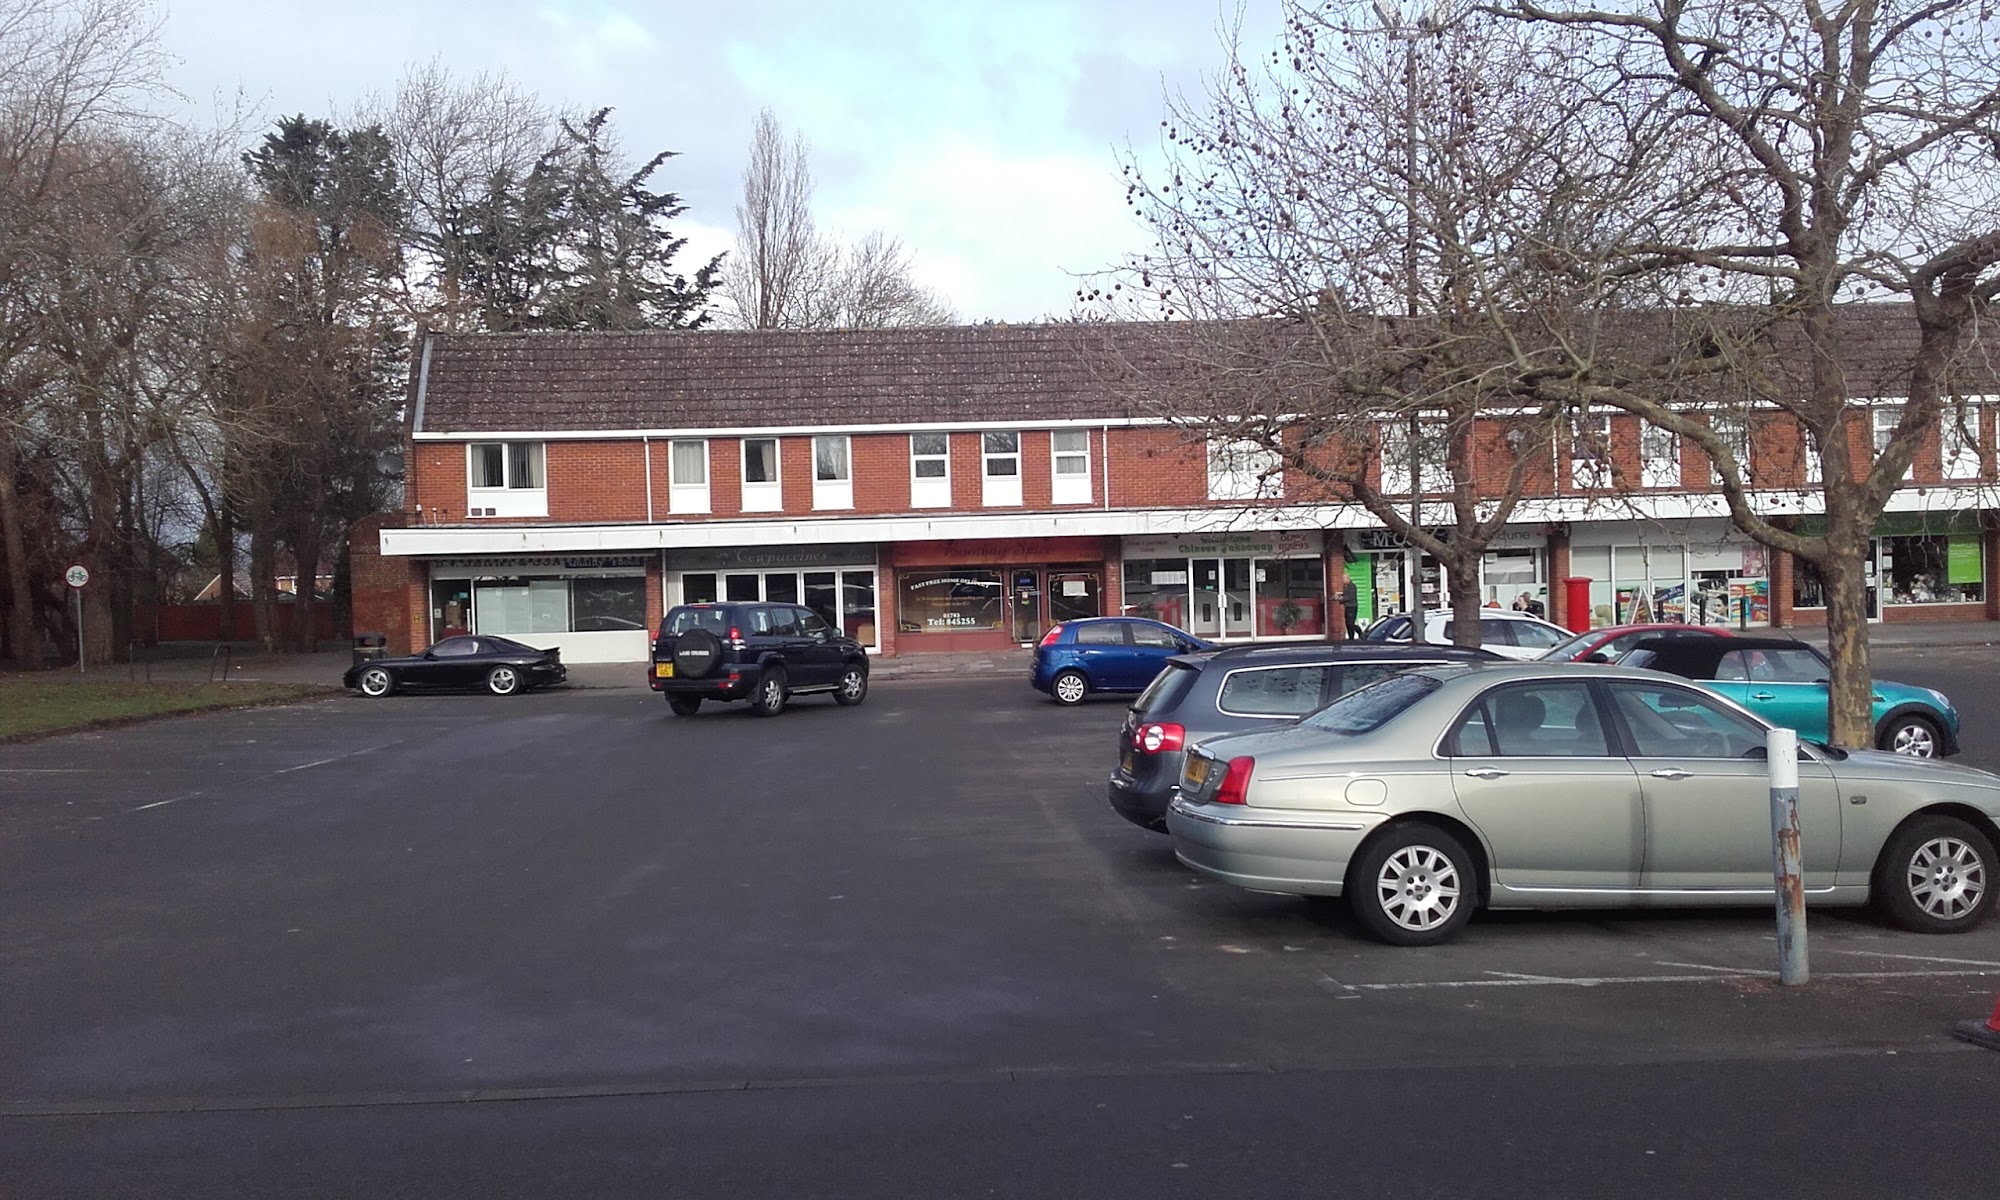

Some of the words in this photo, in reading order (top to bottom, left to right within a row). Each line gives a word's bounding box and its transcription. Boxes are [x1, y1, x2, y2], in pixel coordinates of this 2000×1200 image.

[1178, 544, 1216, 553] Chinese
[1221, 543, 1273, 554] Takeaway
[910, 582, 926, 591] FAST
[927, 618, 945, 626] Tel:
[946, 617, 976, 626] 845255
